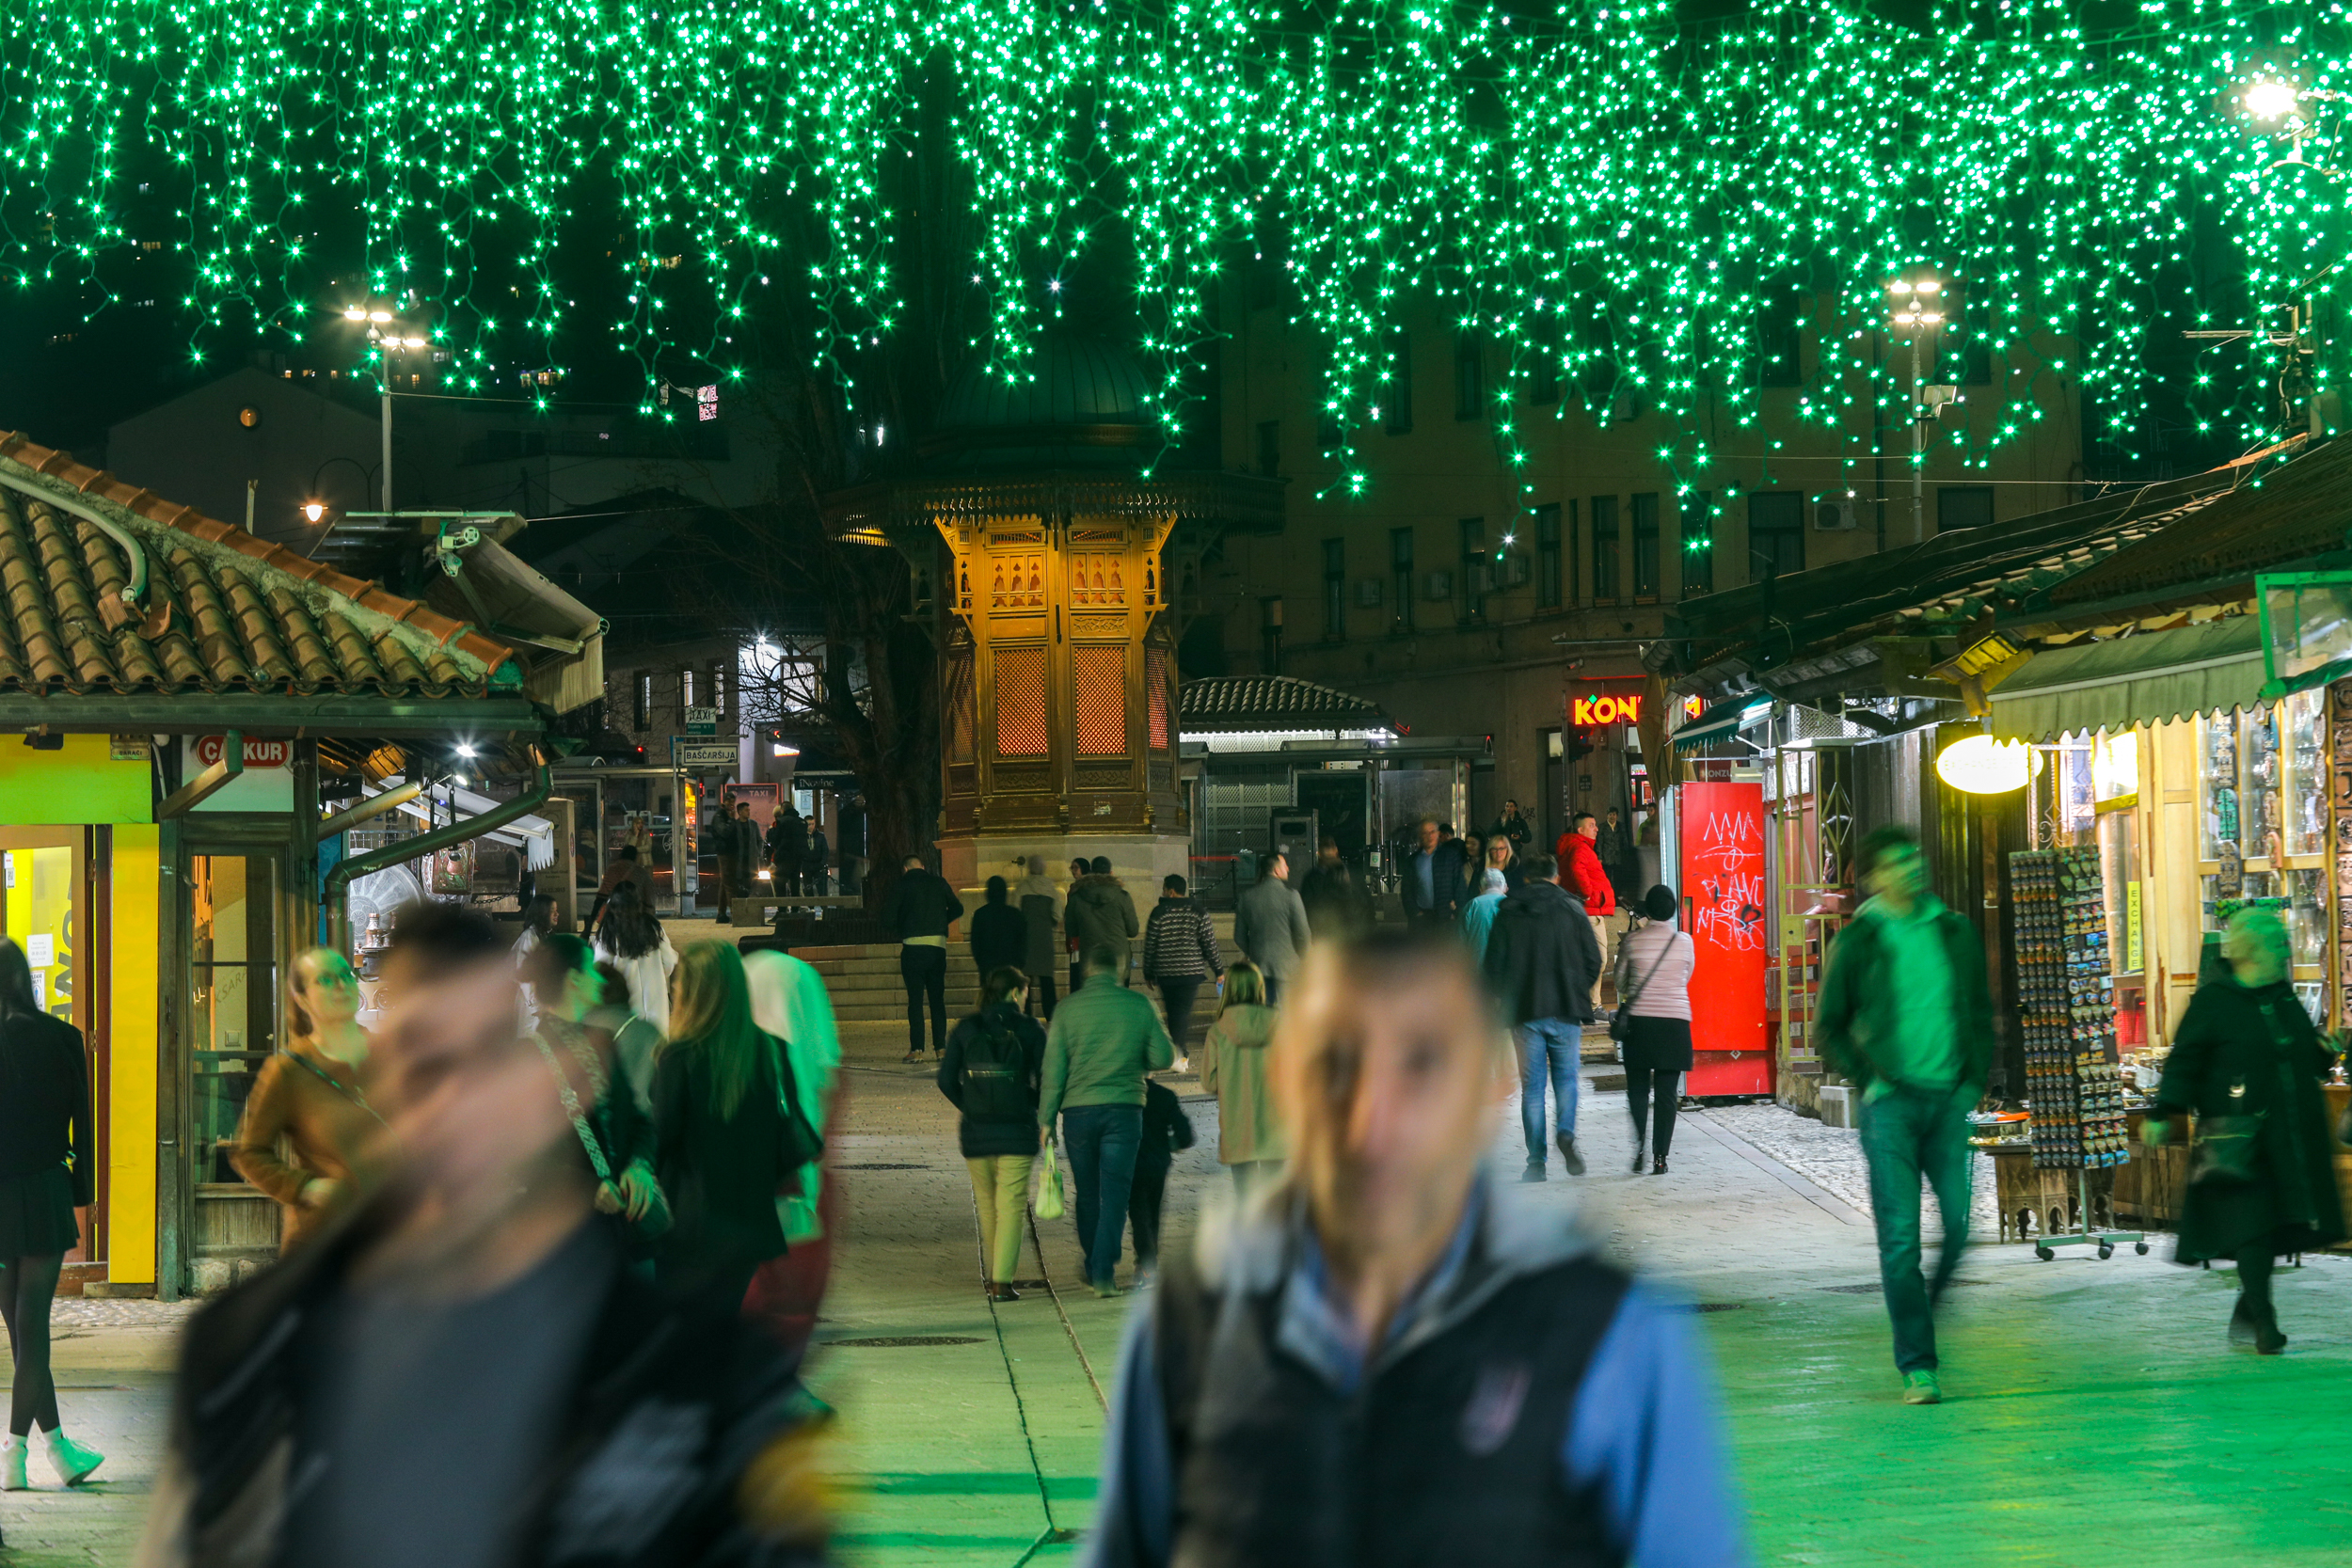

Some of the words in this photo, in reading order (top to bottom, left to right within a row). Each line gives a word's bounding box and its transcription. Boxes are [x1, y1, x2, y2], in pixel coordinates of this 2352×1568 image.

[691, 709, 711, 721] TAXI
[204, 742, 282, 764] ÇKUR
[686, 750, 736, 760] BAŠČARŠIJA
